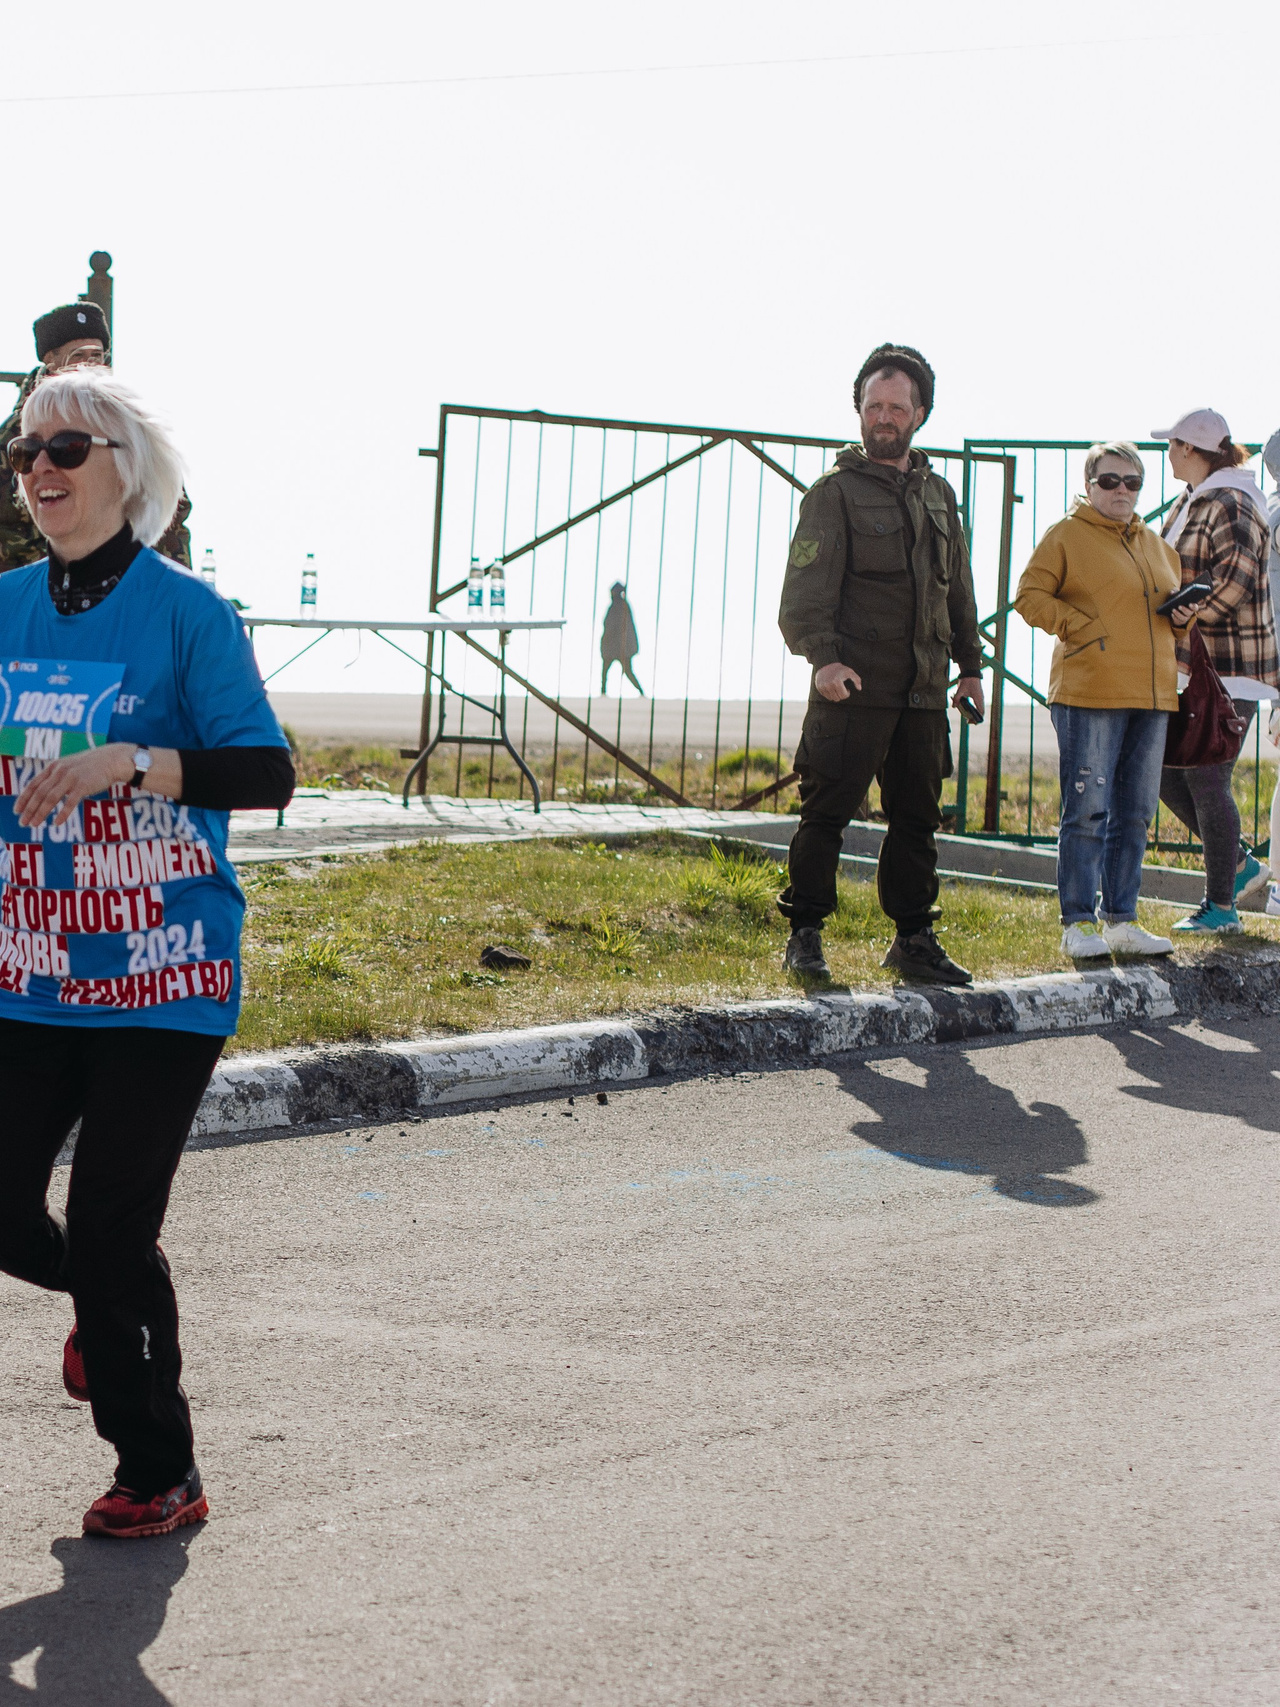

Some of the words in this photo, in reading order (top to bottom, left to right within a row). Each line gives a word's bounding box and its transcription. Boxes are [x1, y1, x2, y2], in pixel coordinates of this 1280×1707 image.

[13, 691, 89, 726] 10035
[73, 838, 218, 888] #МОМЕНТ
[1, 883, 165, 934] #ГОРДОСТЬ
[126, 920, 207, 975] 2024
[58, 959, 233, 1009] #ЕДИНСТВО
